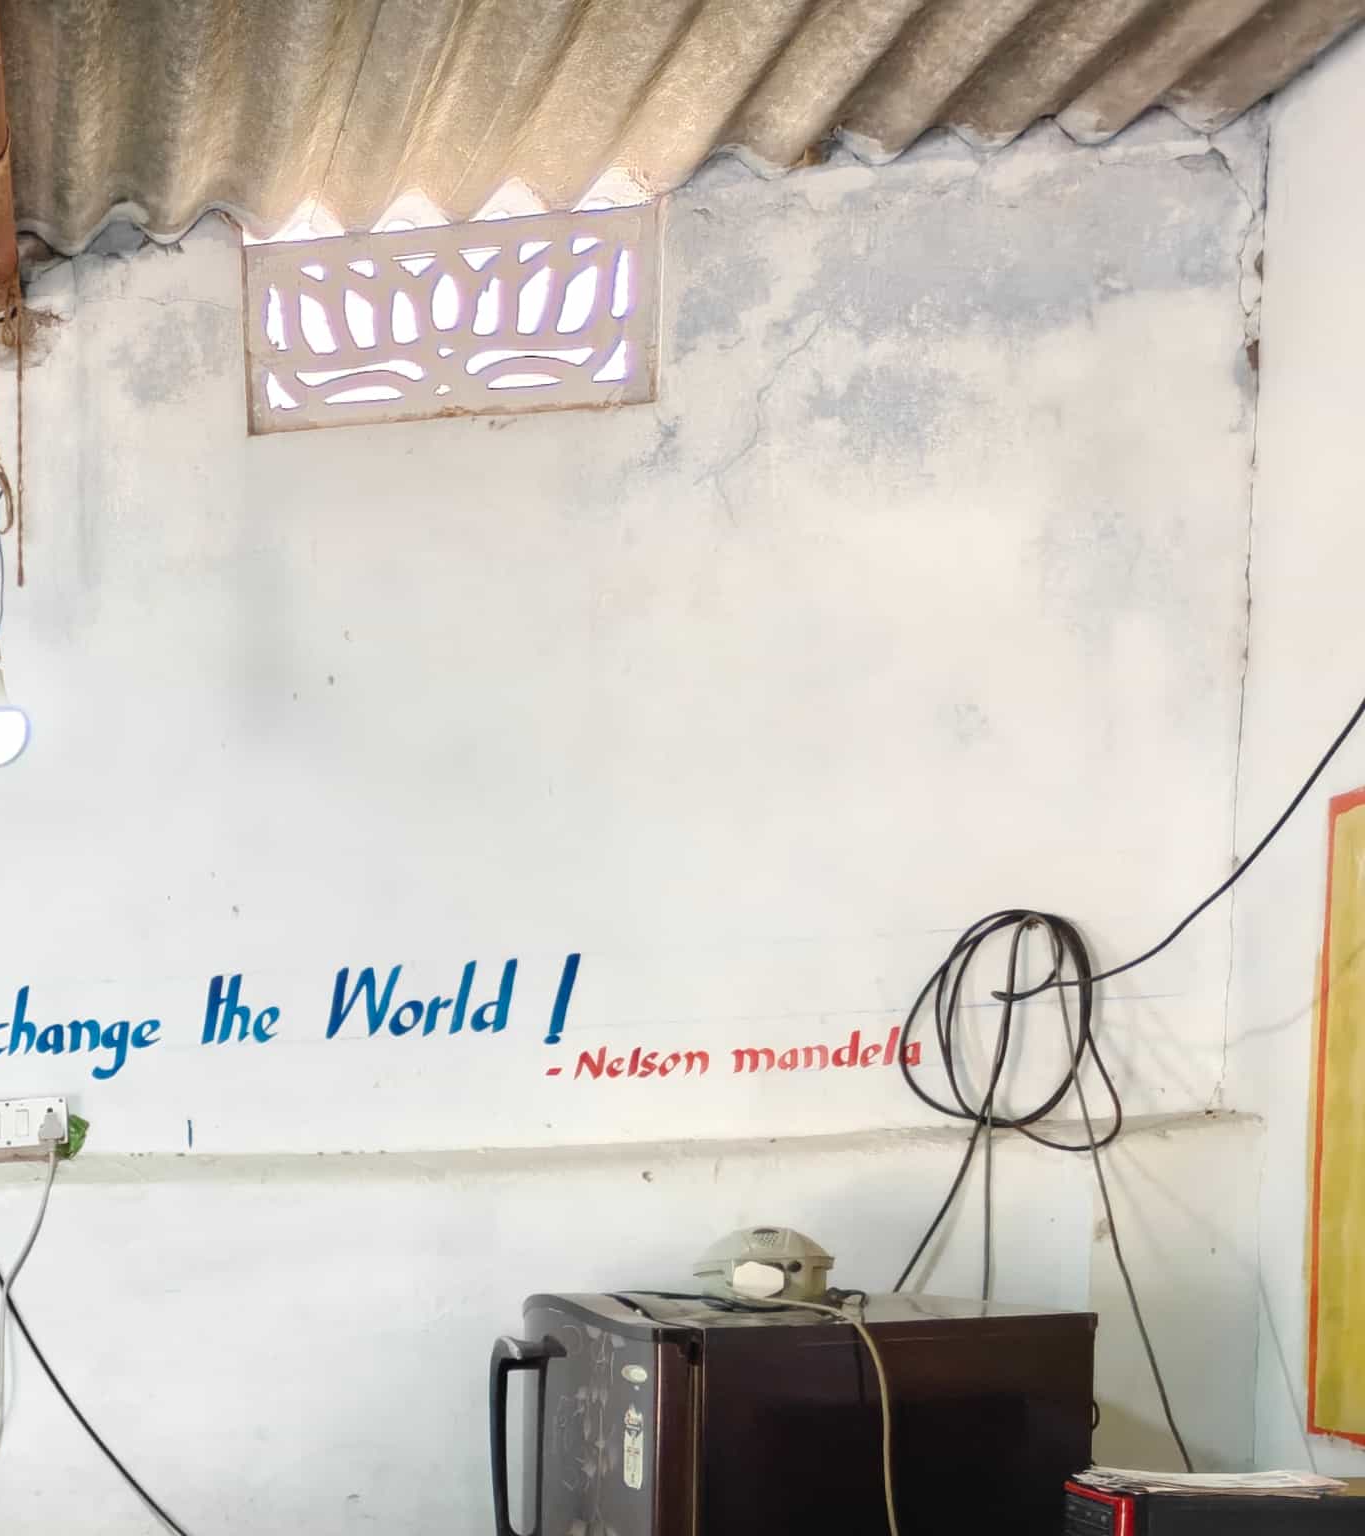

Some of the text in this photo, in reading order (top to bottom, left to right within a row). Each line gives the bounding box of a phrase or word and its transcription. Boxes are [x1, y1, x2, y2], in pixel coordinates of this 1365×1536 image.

[201, 973, 280, 1046] the
[325, 958, 518, 1039] World
[732, 1026, 922, 1075] mandela
